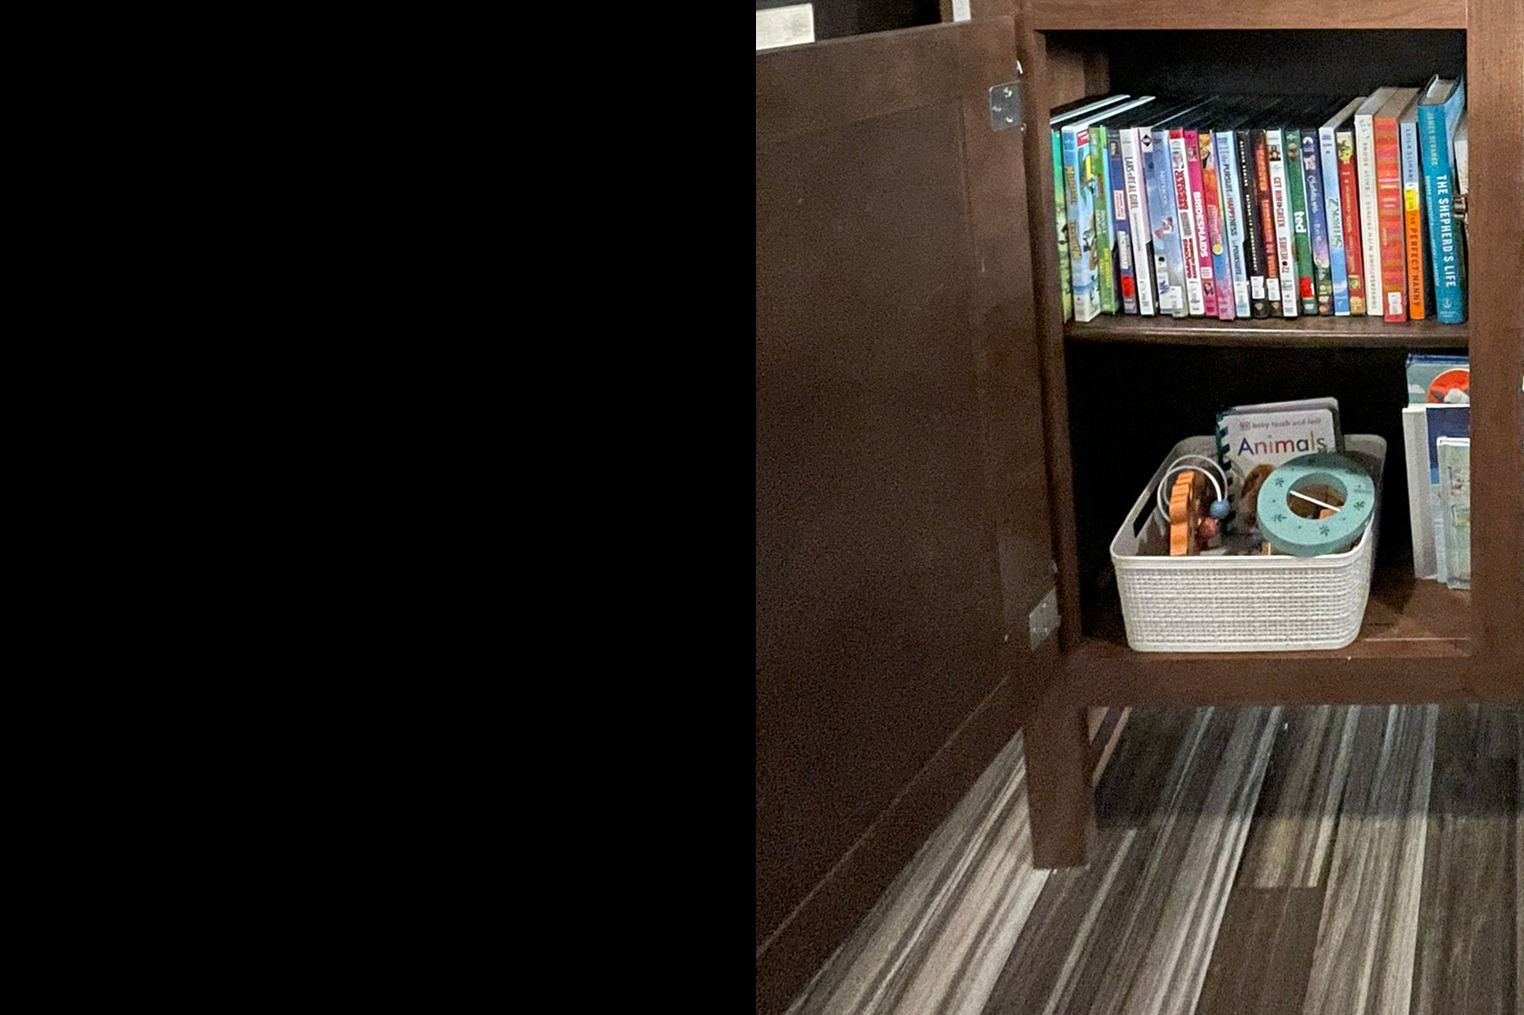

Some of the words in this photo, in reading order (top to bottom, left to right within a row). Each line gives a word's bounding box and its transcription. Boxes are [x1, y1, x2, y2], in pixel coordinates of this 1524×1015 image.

[1426, 112, 1436, 137] JAMES
[1125, 156, 1134, 173] LARS
[1128, 175, 1137, 193] REAL
[1223, 164, 1232, 192] PURSUIT
[1274, 176, 1282, 188] GET
[1437, 174, 1448, 195] THE
[1130, 194, 1139, 209] GIRL
[1193, 191, 1208, 258] BRIDESMAIDS
[1227, 197, 1238, 236] HAPPYNESS
[1276, 208, 1285, 227] GREEK
[1294, 211, 1306, 233] ted
[1438, 199, 1454, 262] SHEPHERD'S
[1410, 227, 1419, 270] PERFECT
[1444, 265, 1457, 288] LIFE
[1412, 274, 1421, 307] NANNY
[1238, 431, 1327, 456] Animals
